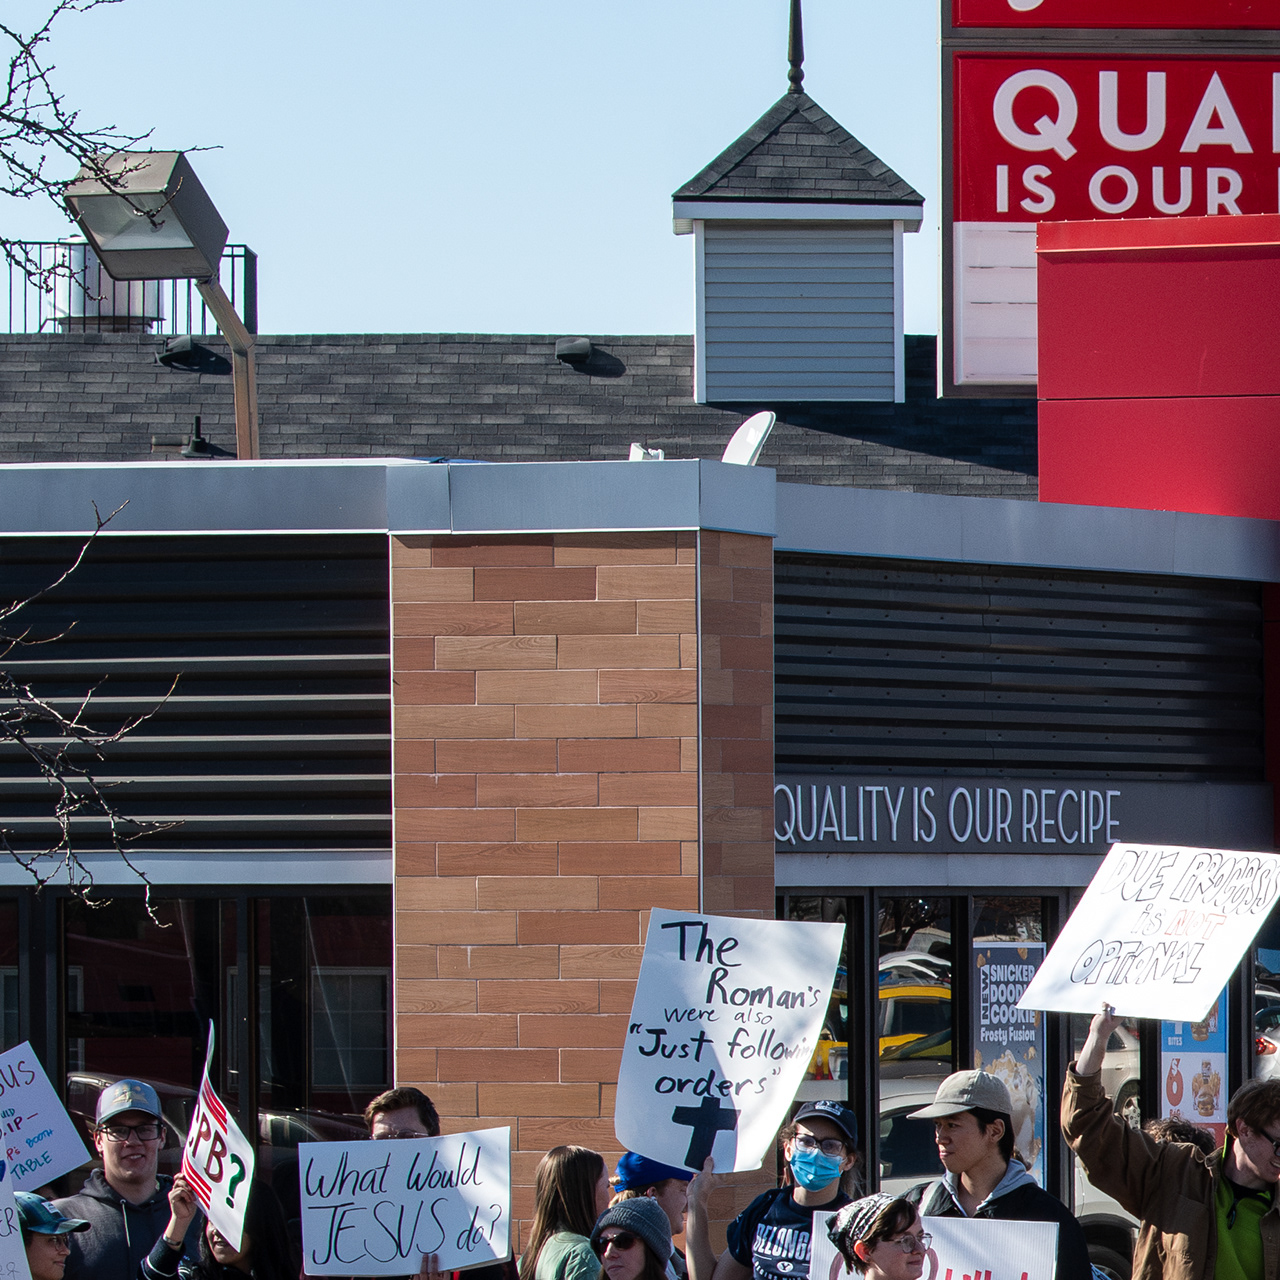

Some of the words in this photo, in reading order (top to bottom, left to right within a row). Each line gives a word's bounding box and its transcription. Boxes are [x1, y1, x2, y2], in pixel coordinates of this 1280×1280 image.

[996, 165, 1056, 213] IS
[1088, 165, 1243, 214] OUR
[774, 784, 904, 845] QUALITY
[913, 787, 936, 842] IS
[949, 787, 1012, 843] OUR
[1022, 789, 1121, 844] RECIPE
[1101, 850, 1180, 903] DUE
[660, 920, 742, 968] The
[1164, 908, 1227, 941] NOT
[705, 966, 821, 1010] Roman's
[981, 965, 990, 1021] NEW
[663, 1007, 720, 1024] were
[733, 1007, 773, 1026] also
[980, 1027, 1008, 1046] Frosty
[1009, 1025, 1035, 1041] Fusion
[990, 1004, 1036, 1024] COOKIE
[1168, 1036, 1183, 1046] BITES
[25, 1128, 54, 1148] BOOTH
[10, 1151, 52, 1180] TABLE
[305, 1151, 392, 1198] What
[407, 1141, 484, 1192] Would
[307, 1197, 449, 1265] JESUS
[456, 1203, 503, 1253] do?
